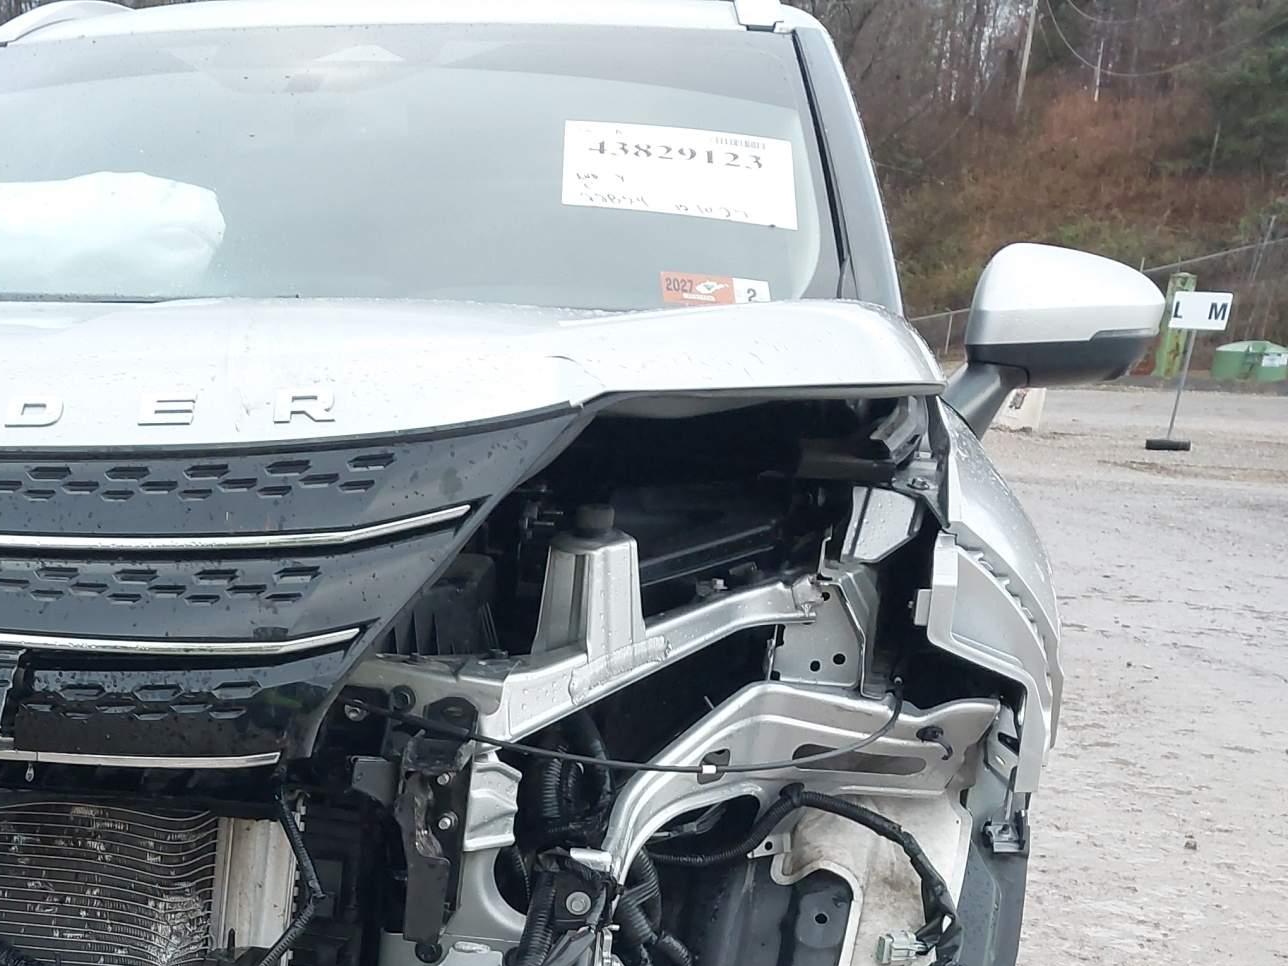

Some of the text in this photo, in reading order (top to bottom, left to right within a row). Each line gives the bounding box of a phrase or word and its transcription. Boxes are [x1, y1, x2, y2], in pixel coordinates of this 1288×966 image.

[587, 140, 763, 169] 43829123
[665, 277, 694, 293] 2027
[1173, 302, 1228, 320] L M
